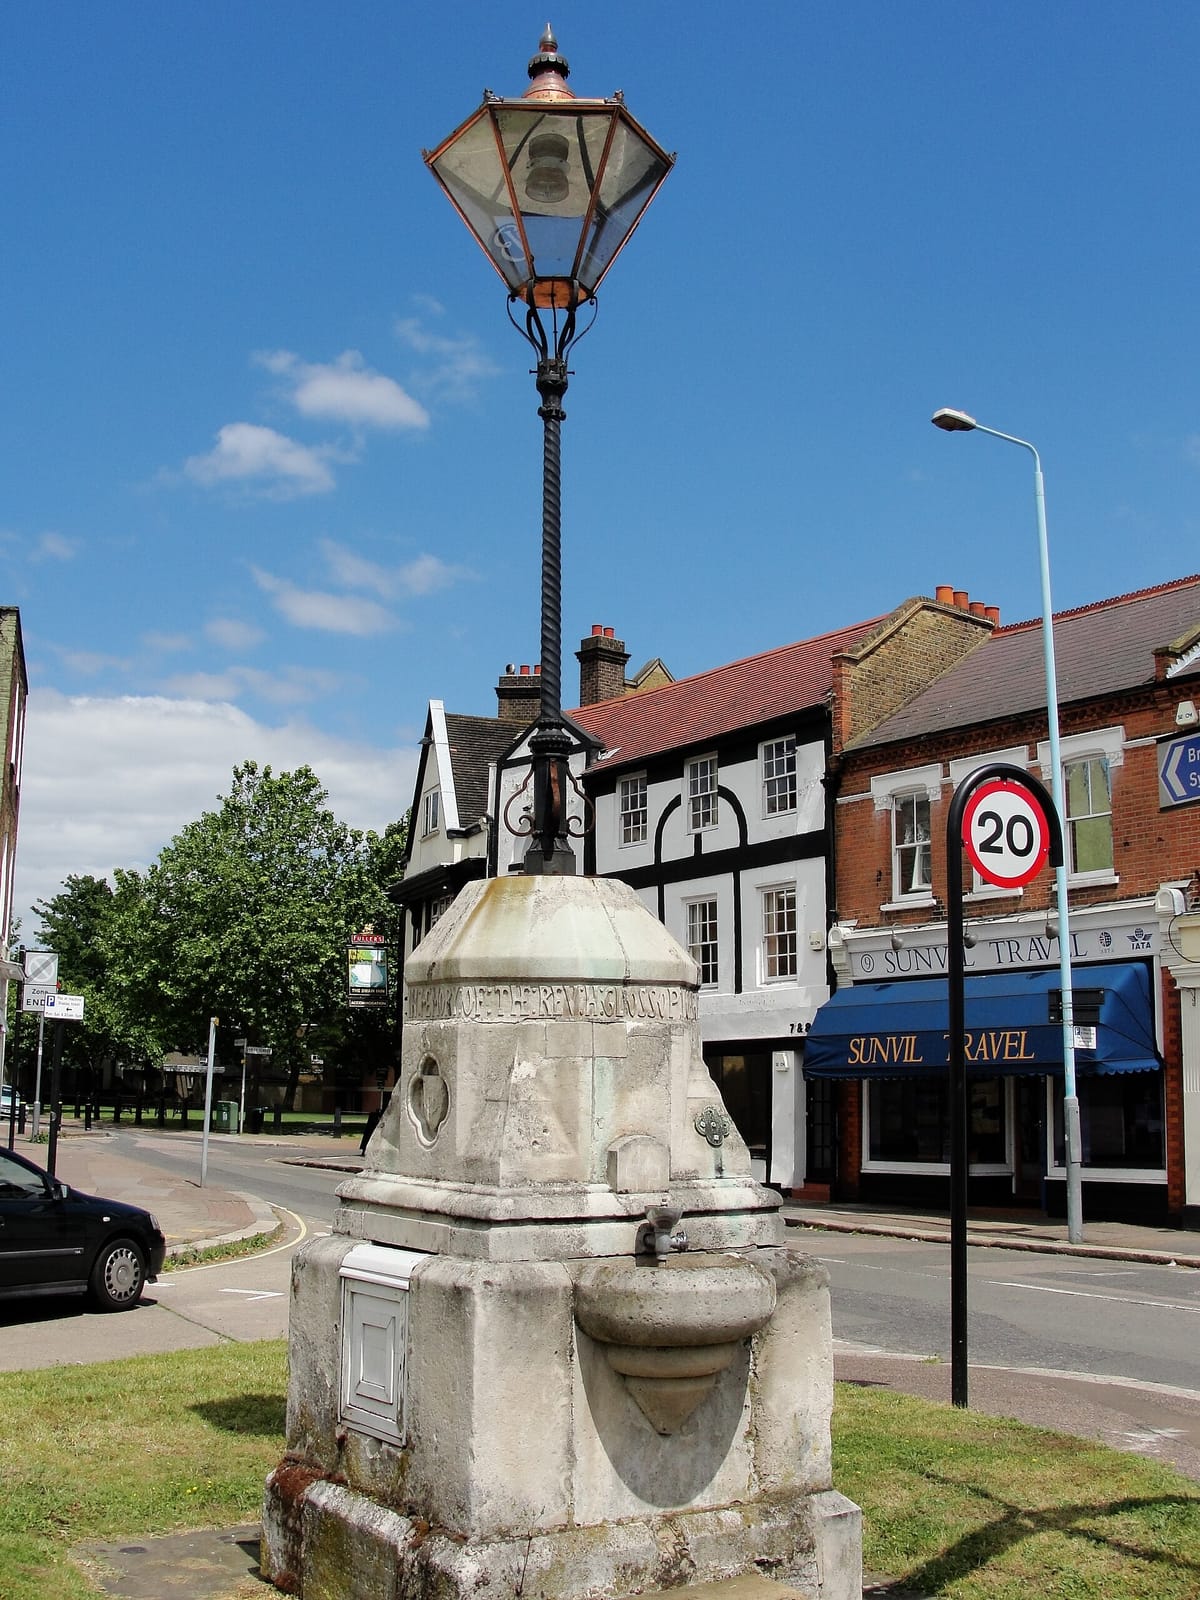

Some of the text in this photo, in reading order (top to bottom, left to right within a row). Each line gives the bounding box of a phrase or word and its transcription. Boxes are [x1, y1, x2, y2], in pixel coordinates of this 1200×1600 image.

[977, 811, 1034, 857] 20
[884, 946, 976, 973] SUNVL
[1131, 942, 1151, 950] IATA
[847, 1035, 923, 1064] SUNVIL
